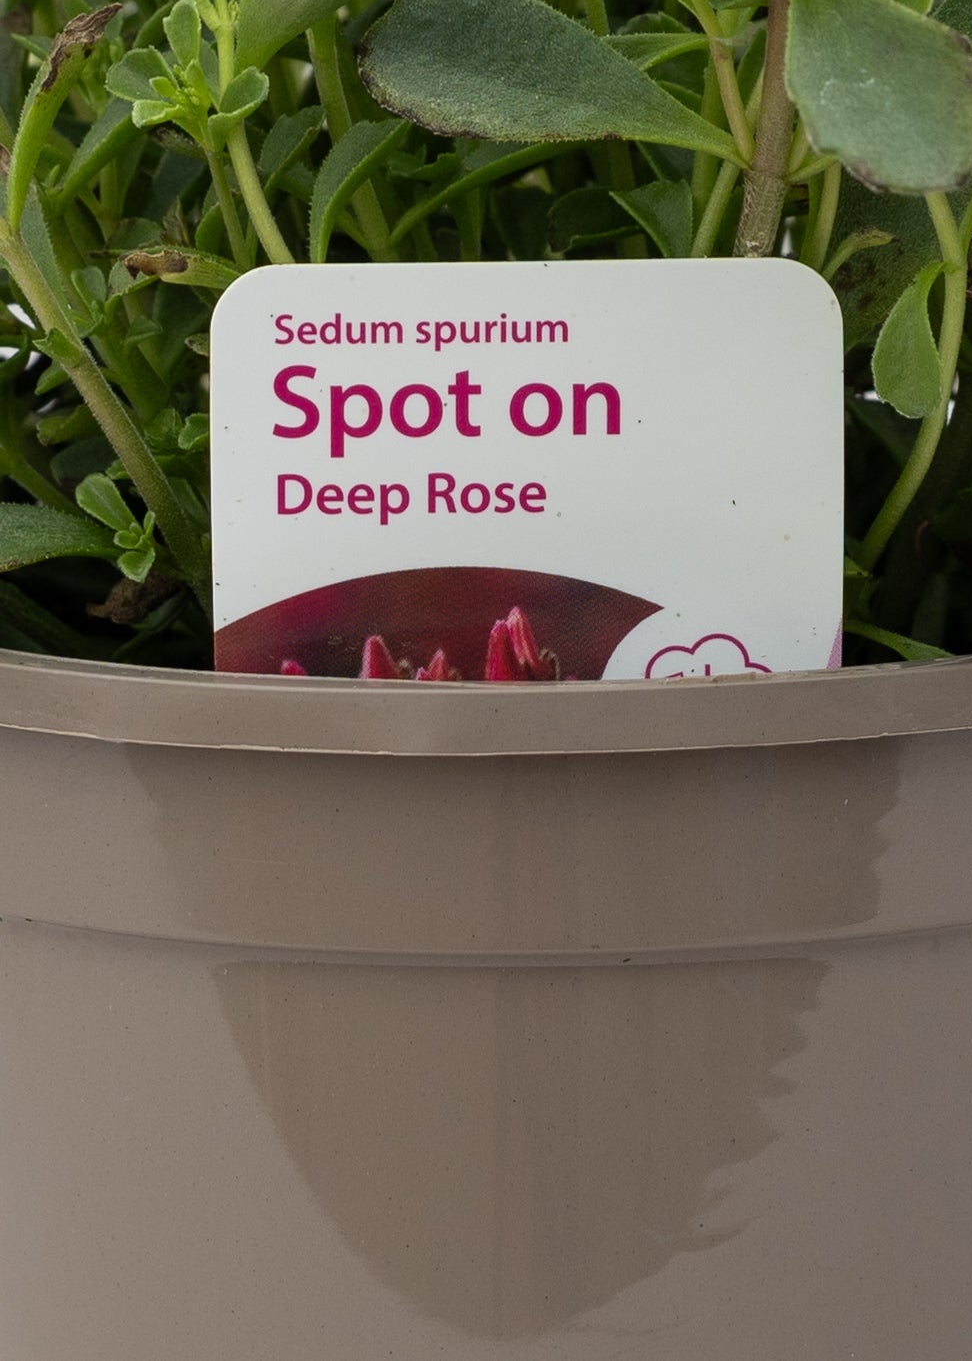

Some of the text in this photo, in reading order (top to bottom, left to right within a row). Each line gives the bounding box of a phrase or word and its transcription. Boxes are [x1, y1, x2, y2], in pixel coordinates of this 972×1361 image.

[274, 313, 570, 351] Sedum spurium
[272, 364, 622, 459] Spot on
[277, 472, 548, 526] Deep Rose
